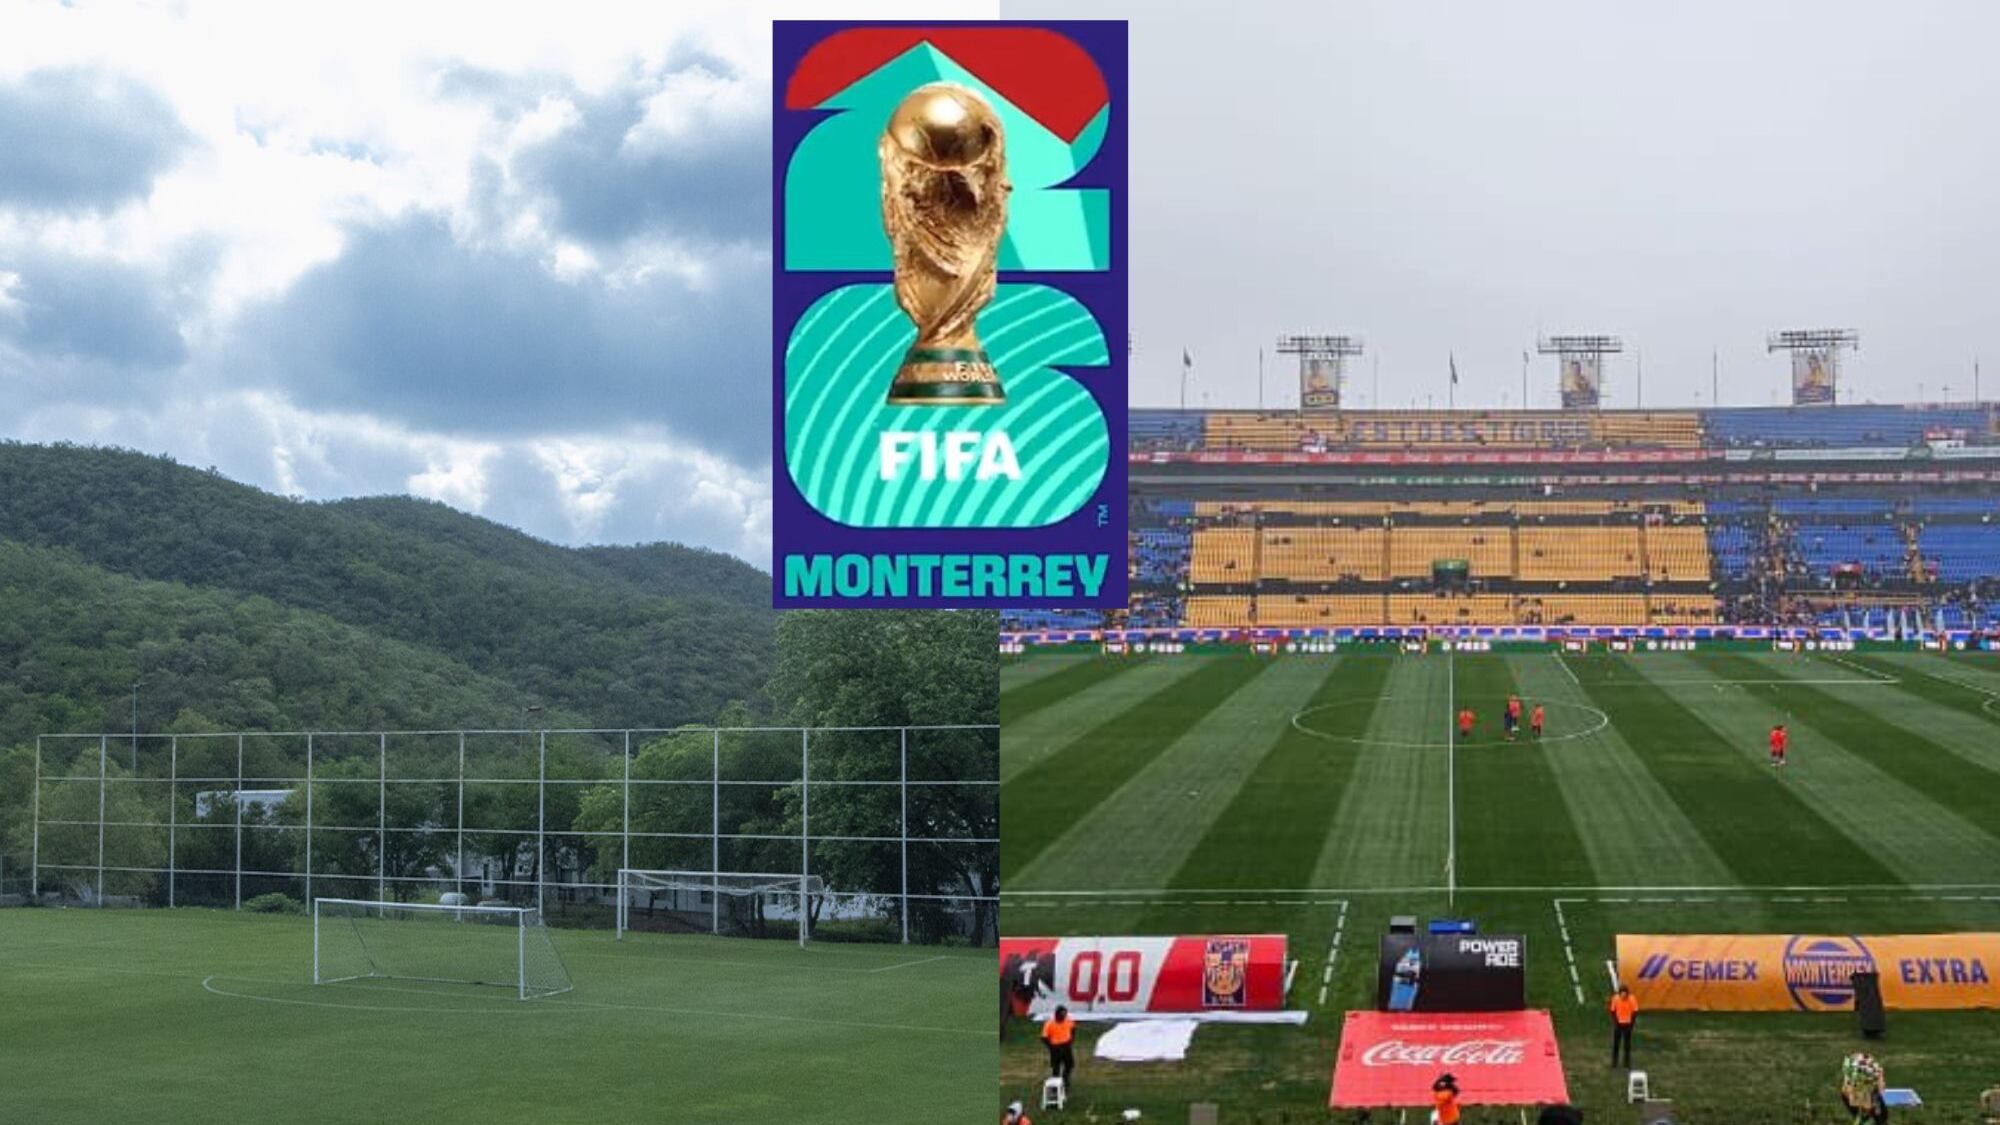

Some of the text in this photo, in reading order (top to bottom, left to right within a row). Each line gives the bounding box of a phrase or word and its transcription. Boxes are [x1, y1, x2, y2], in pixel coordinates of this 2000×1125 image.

[1459, 940, 1518, 953] POWER
[1486, 952, 1520, 967] ADE
[1668, 959, 1759, 982] CEMEX
[1900, 958, 1989, 985] EXTRA
[1068, 950, 1142, 1003] 0.0
[1362, 1038, 1534, 1067] Coca-Cola
